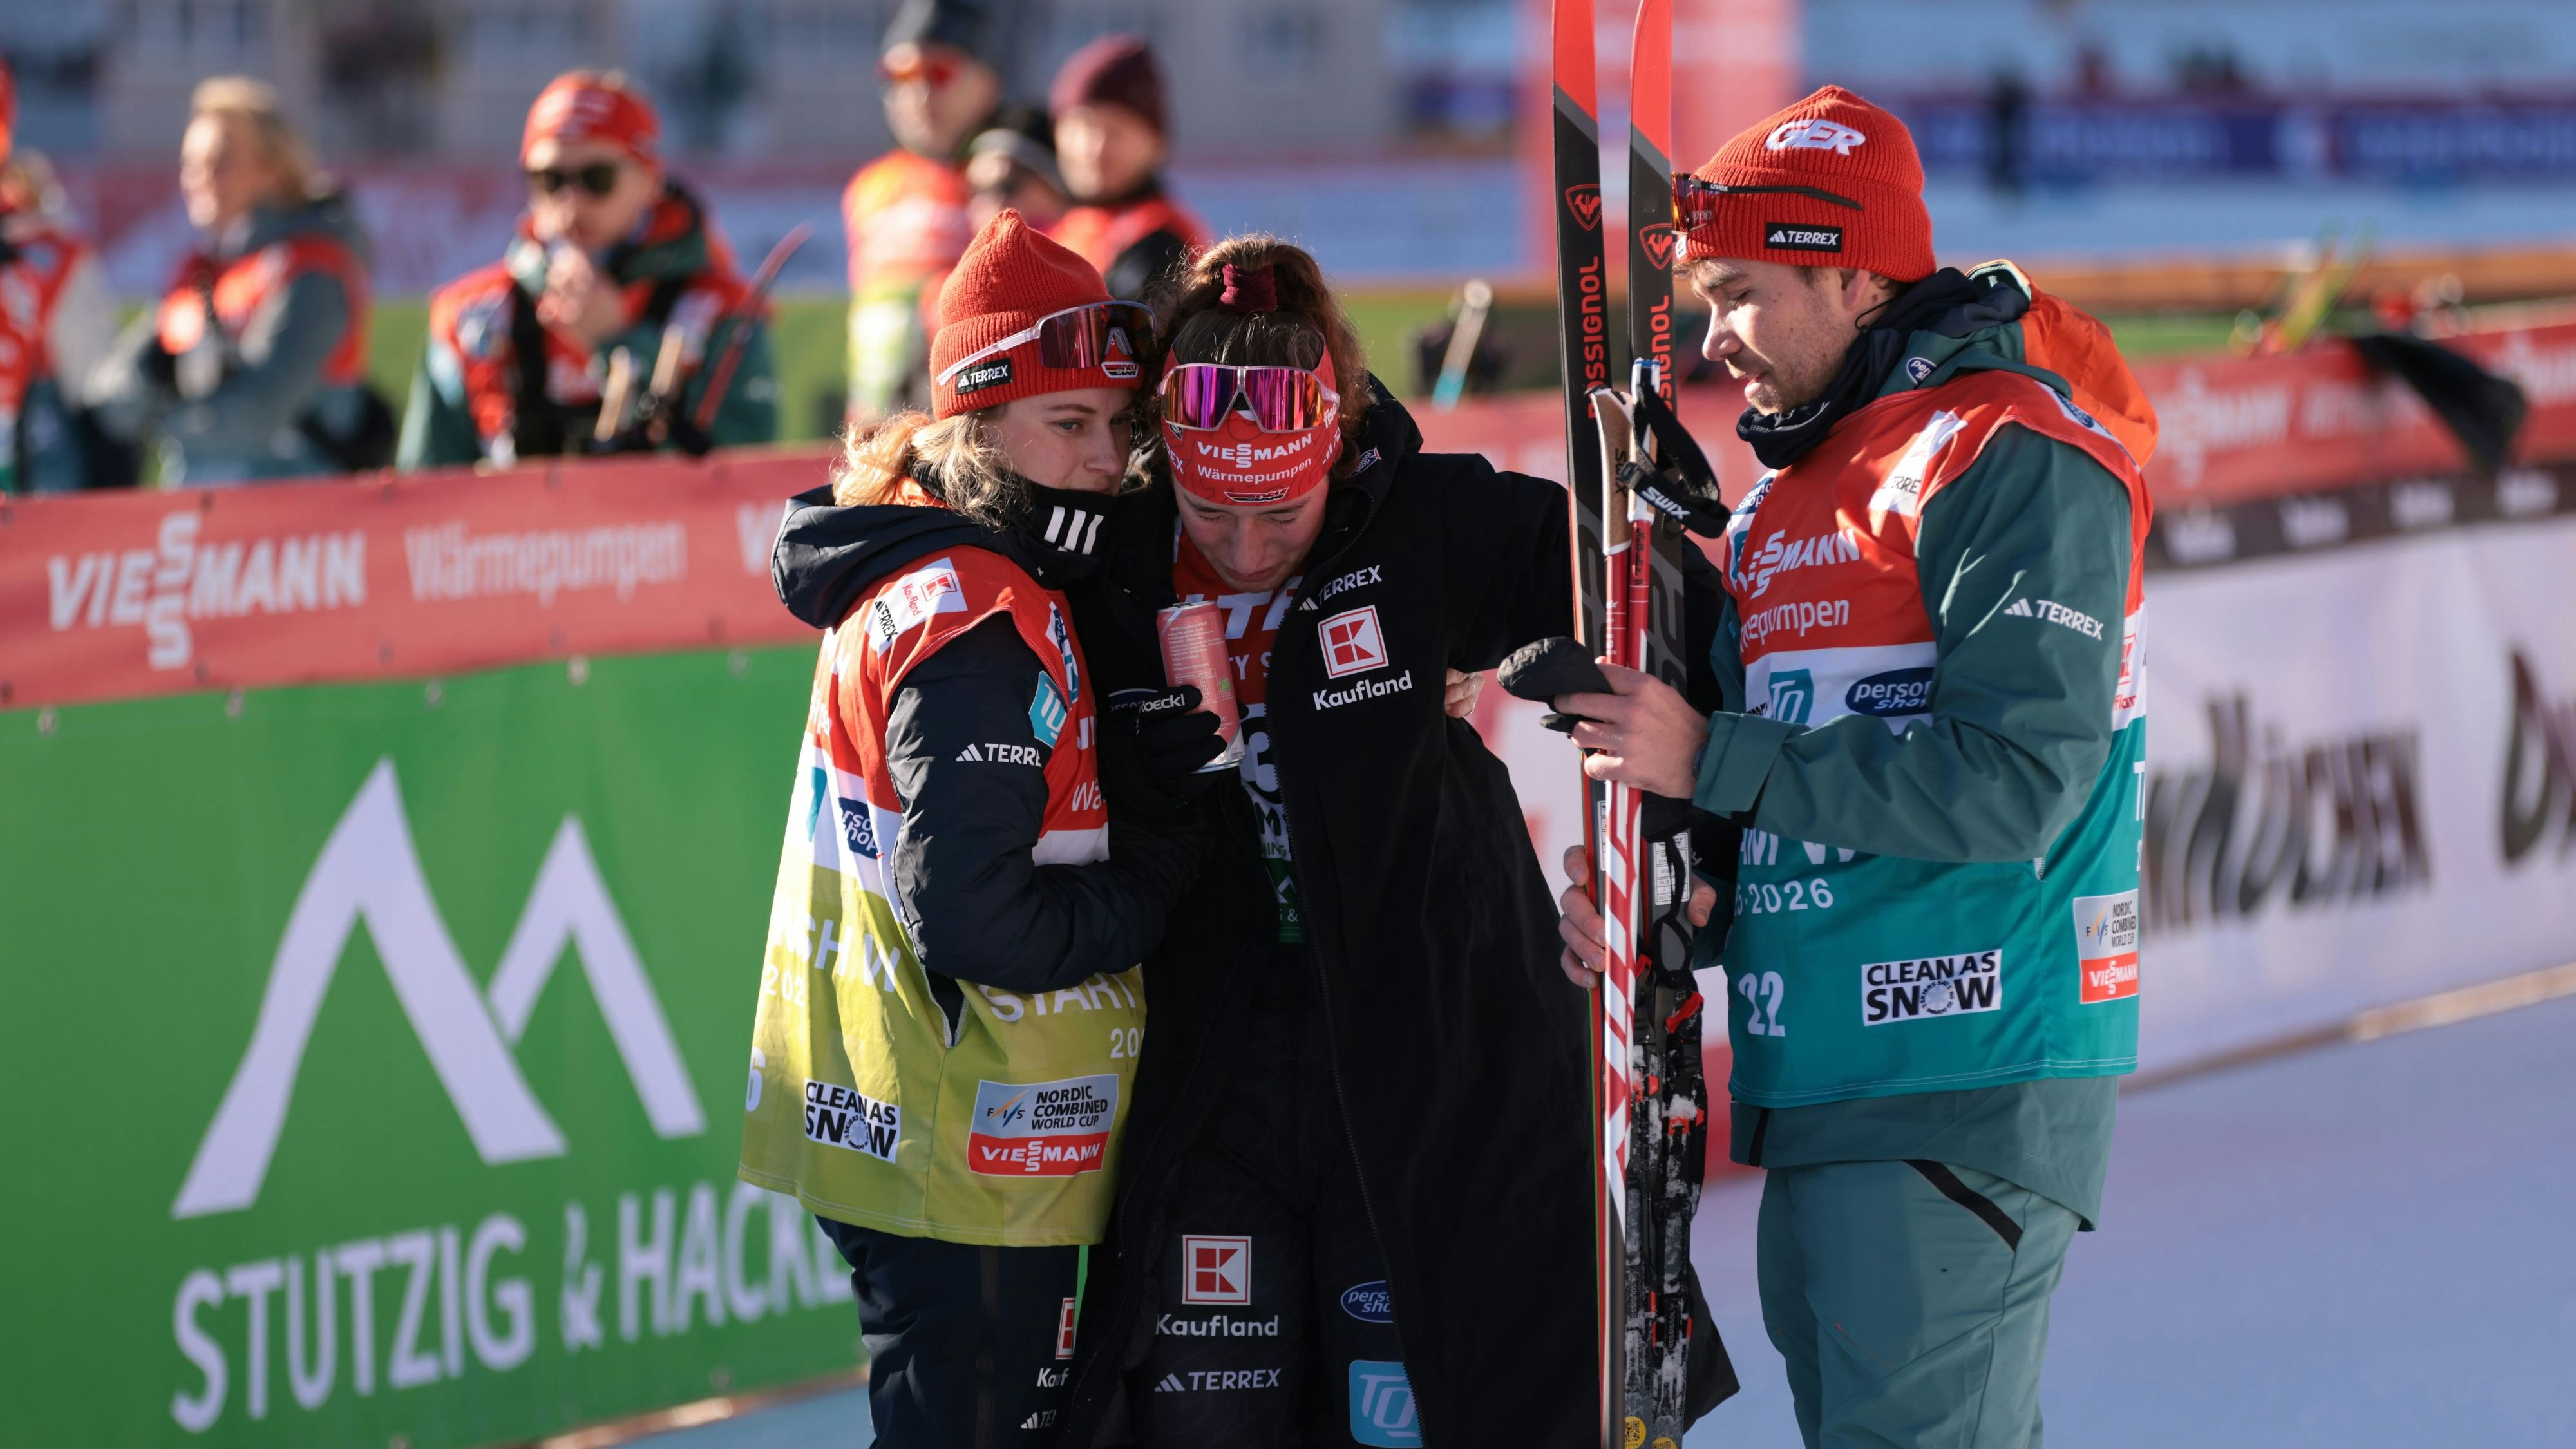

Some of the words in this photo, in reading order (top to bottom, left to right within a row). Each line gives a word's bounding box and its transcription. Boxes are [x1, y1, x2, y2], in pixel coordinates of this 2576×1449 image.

[1765, 118, 1866, 156] GER
[1710, 183, 1729, 192] uvex
[1786, 230, 1839, 245] TERREX
[1650, 295, 1674, 412] SIGNOL
[969, 365, 1009, 385] TERREX
[1197, 432, 1312, 469] VIESSMANN
[1197, 457, 1312, 484] Wärmepumpen
[1642, 486, 1692, 520] SWIX
[48, 509, 366, 671] VIESSMANN
[404, 519, 688, 609] Wärmepumpen
[902, 583, 923, 616] Kaufland
[2036, 599, 2104, 641] TERREX
[1312, 670, 1413, 711] Kaufland
[1853, 680, 1932, 703] perso
[984, 743, 1042, 768] TERRE
[2112, 900, 2132, 918] NORDIC
[2112, 915, 2137, 934] COMBINED
[2112, 934, 2126, 948] WORLD
[1866, 958, 1955, 987] CLEAN
[1958, 951, 1996, 976] AS
[2089, 960, 2137, 995] VIESSMANN
[806, 1081, 867, 1118] CLEAN
[869, 1102, 896, 1126] AS
[1036, 1084, 1092, 1104] NORDIC
[1033, 1099, 1108, 1118] COMBINED
[1031, 1115, 1076, 1130] WORLD
[1079, 1115, 1099, 1127] CUP
[981, 1140, 1101, 1172] VIESSMANN
[170, 1213, 535, 1432] STUTZIG
[616, 1180, 854, 1345] HACK
[1155, 1313, 1280, 1338] Kaufland
[1188, 1368, 1282, 1391] TERREX
